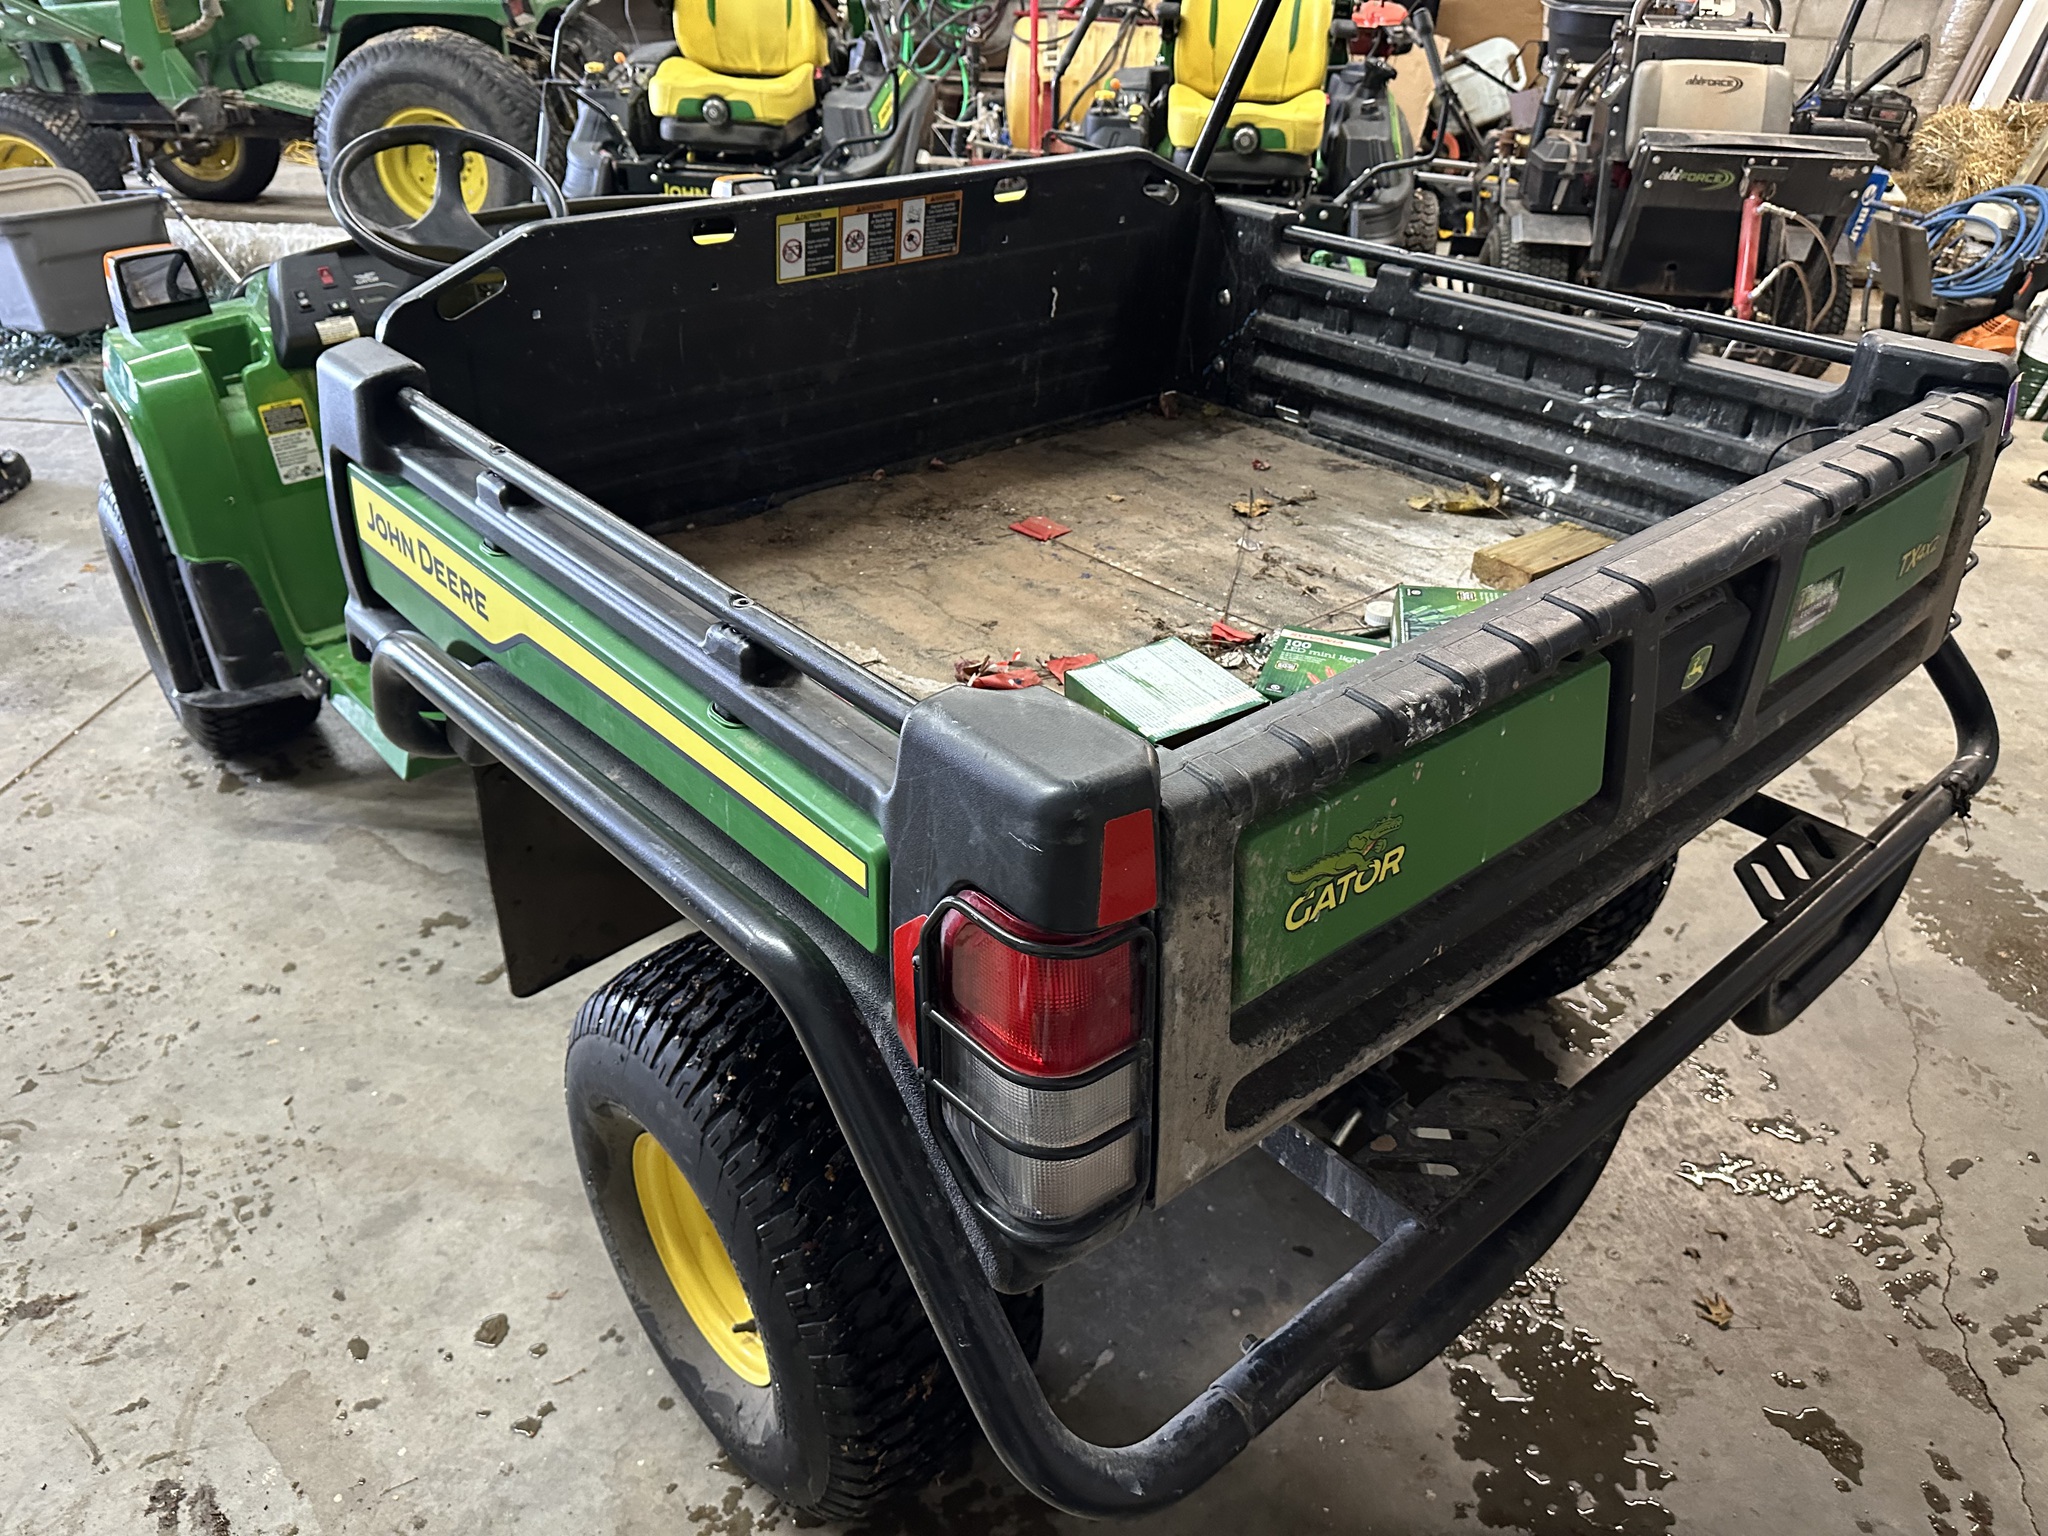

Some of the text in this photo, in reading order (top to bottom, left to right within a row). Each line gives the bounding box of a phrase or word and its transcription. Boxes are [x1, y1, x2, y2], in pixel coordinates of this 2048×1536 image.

[663, 182, 708, 197] JOHN
[367, 502, 490, 623] JOHN DEERE
[1284, 639, 1312, 649] 100
[1283, 645, 1307, 654] LED
[1308, 649, 1336, 660] mini
[1285, 845, 1405, 932] GATOR
